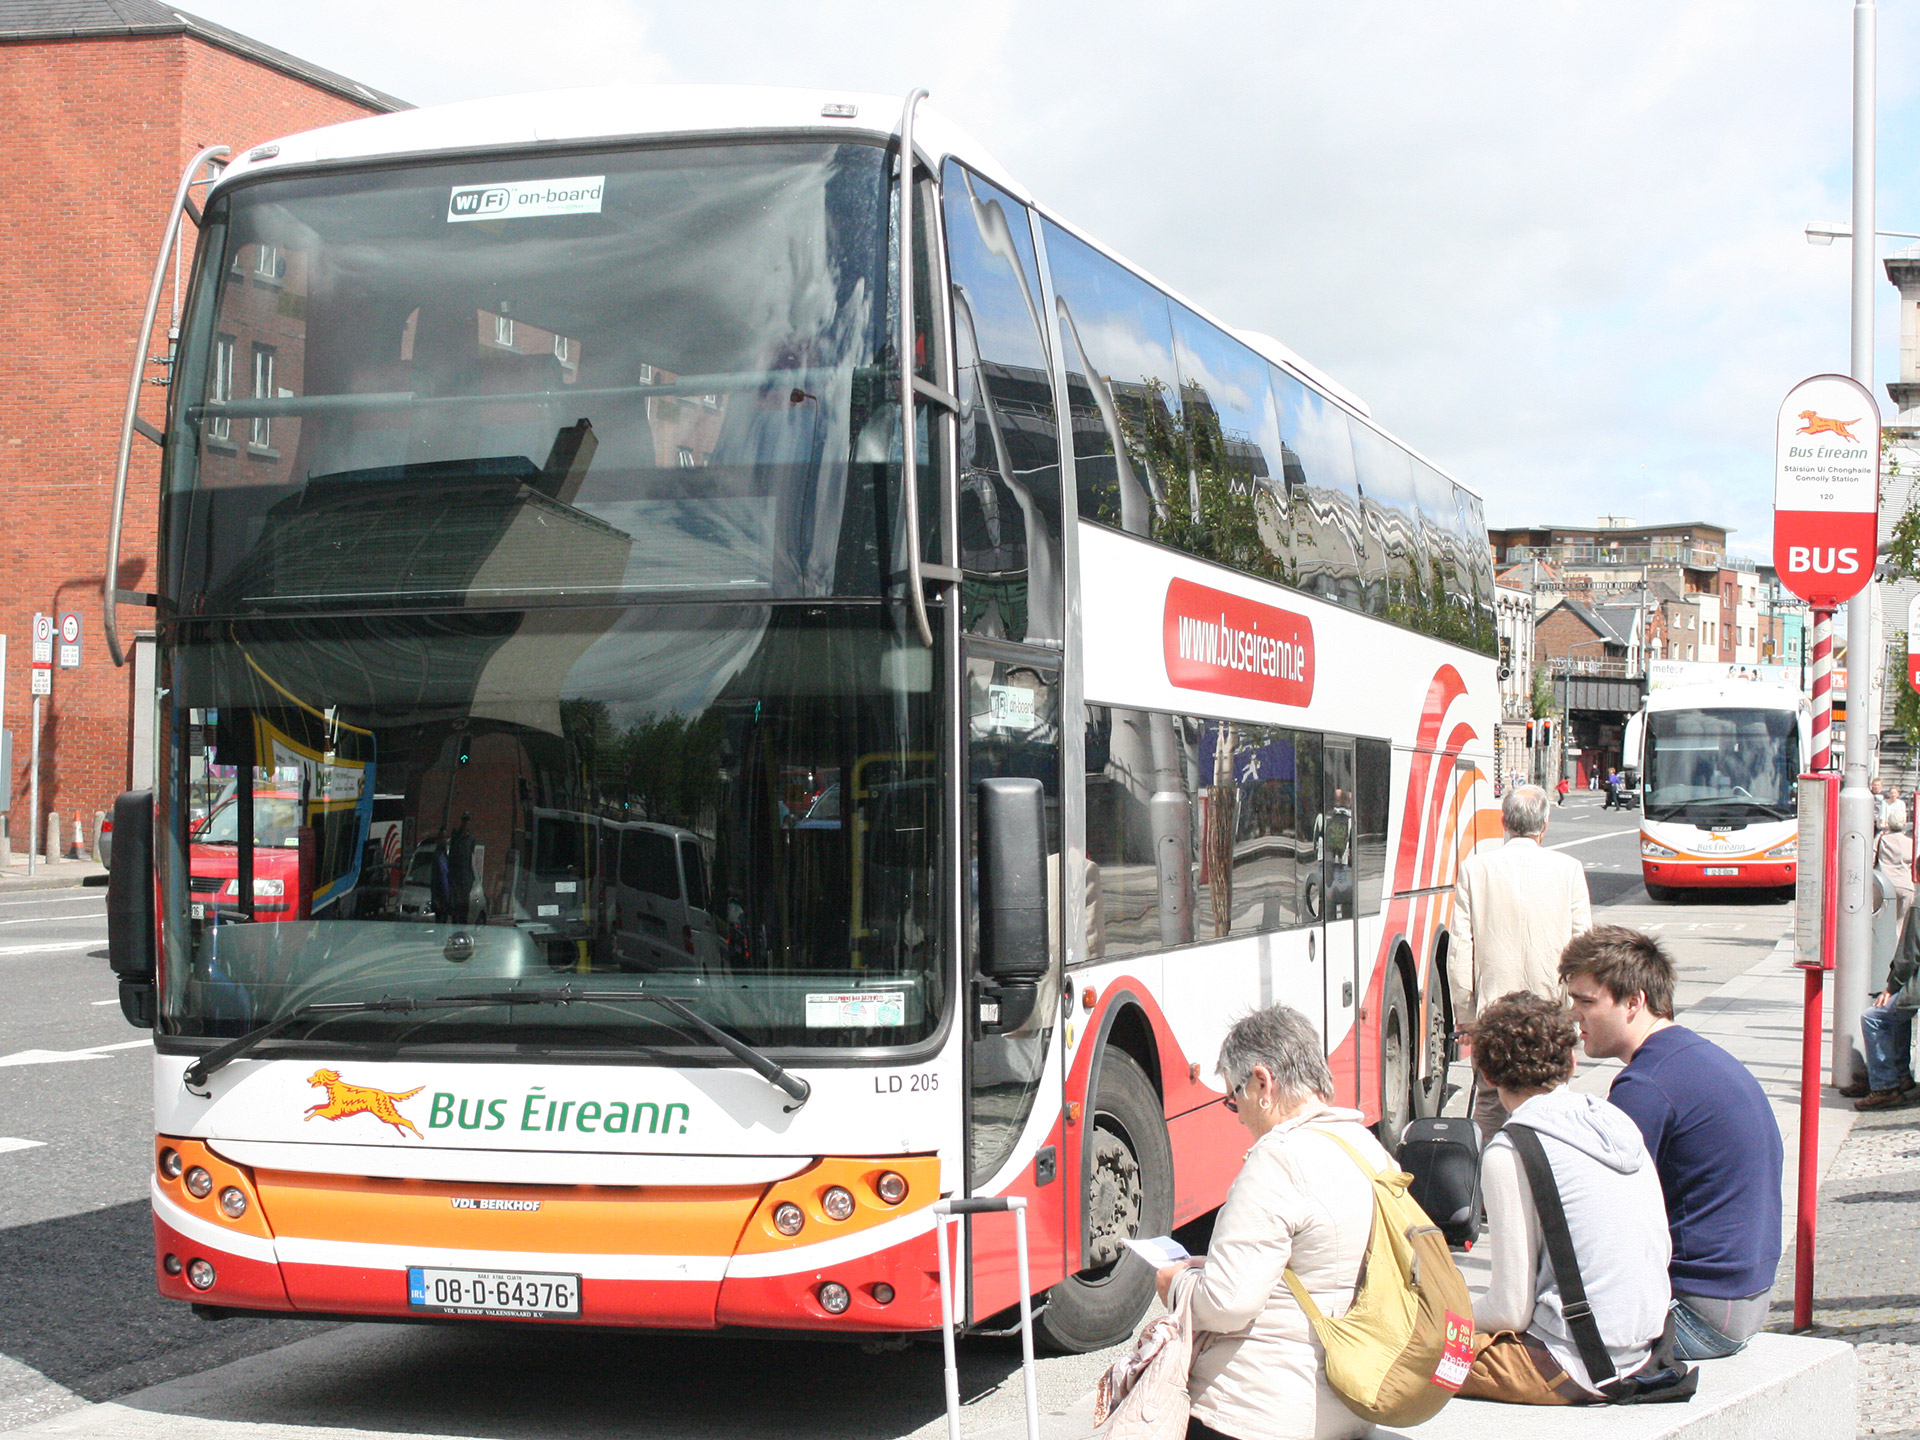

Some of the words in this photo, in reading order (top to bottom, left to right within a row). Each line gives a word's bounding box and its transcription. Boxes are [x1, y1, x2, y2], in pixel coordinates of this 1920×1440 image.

[455, 192, 505, 211] WiFi
[518, 185, 602, 205] on-board
[1789, 446, 1814, 458] Bus
[1795, 474, 1829, 483] Connolly
[1831, 475, 1859, 483] Station
[1788, 546, 1859, 575] BUS
[1178, 612, 1305, 682] www.buseireann.ie
[1697, 843, 1713, 851] Bus
[874, 1075, 903, 1094] LD
[910, 1073, 939, 1092] 205
[428, 1091, 507, 1131] Bus
[451, 1197, 477, 1209] VDL
[479, 1199, 541, 1212] BERKHOF
[411, 1289, 425, 1299] IRL
[434, 1278, 569, 1309] 08-D-64376
